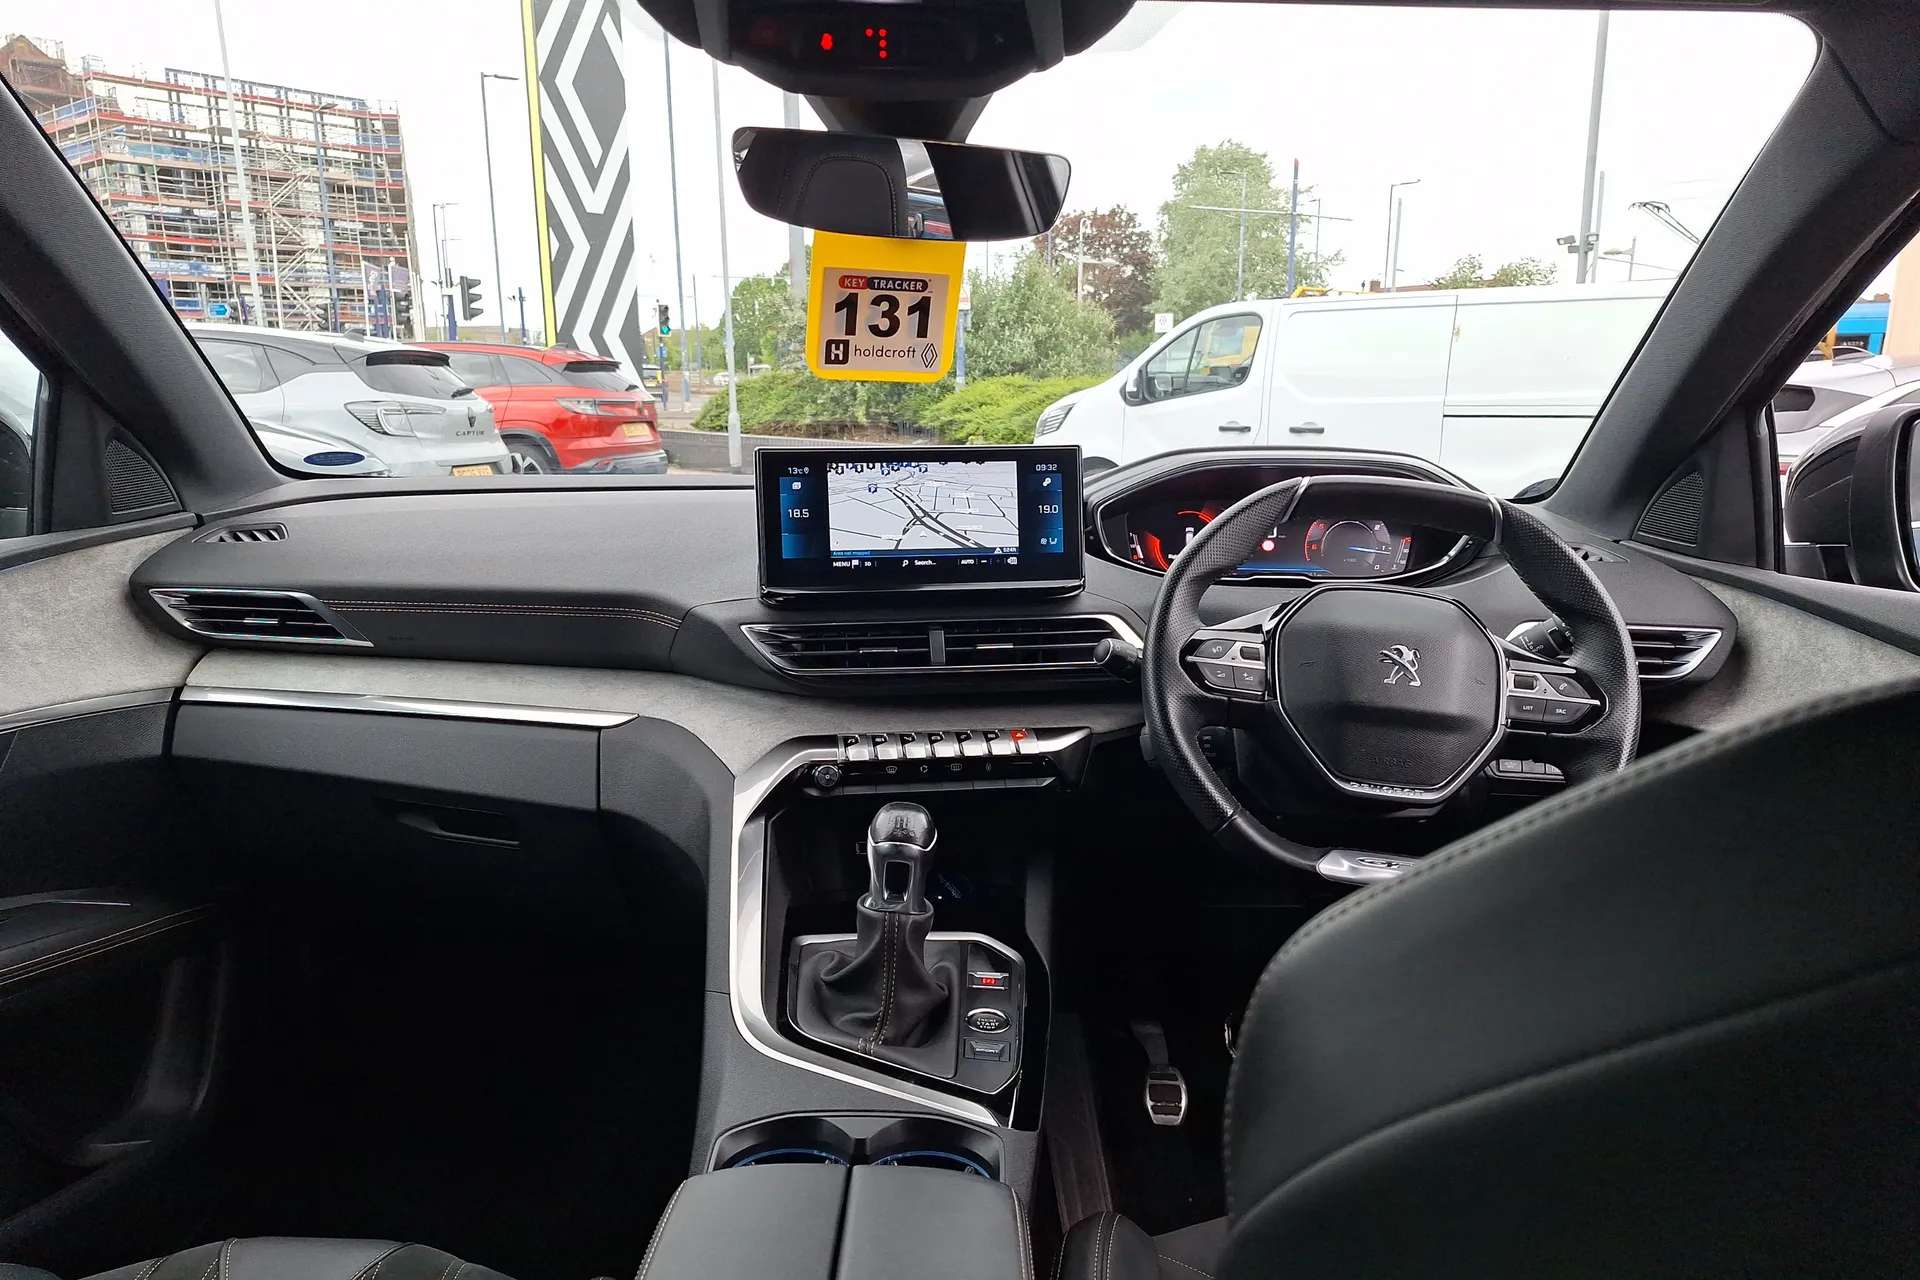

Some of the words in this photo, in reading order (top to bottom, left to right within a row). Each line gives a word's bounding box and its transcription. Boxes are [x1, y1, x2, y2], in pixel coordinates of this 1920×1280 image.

[844, 279, 865, 288] KEY
[873, 279, 923, 291] TRACKER
[834, 292, 931, 338] 131
[854, 345, 917, 359] holdcroft
[788, 508, 810, 518] 18.5
[1038, 504, 1059, 514] 19.0
